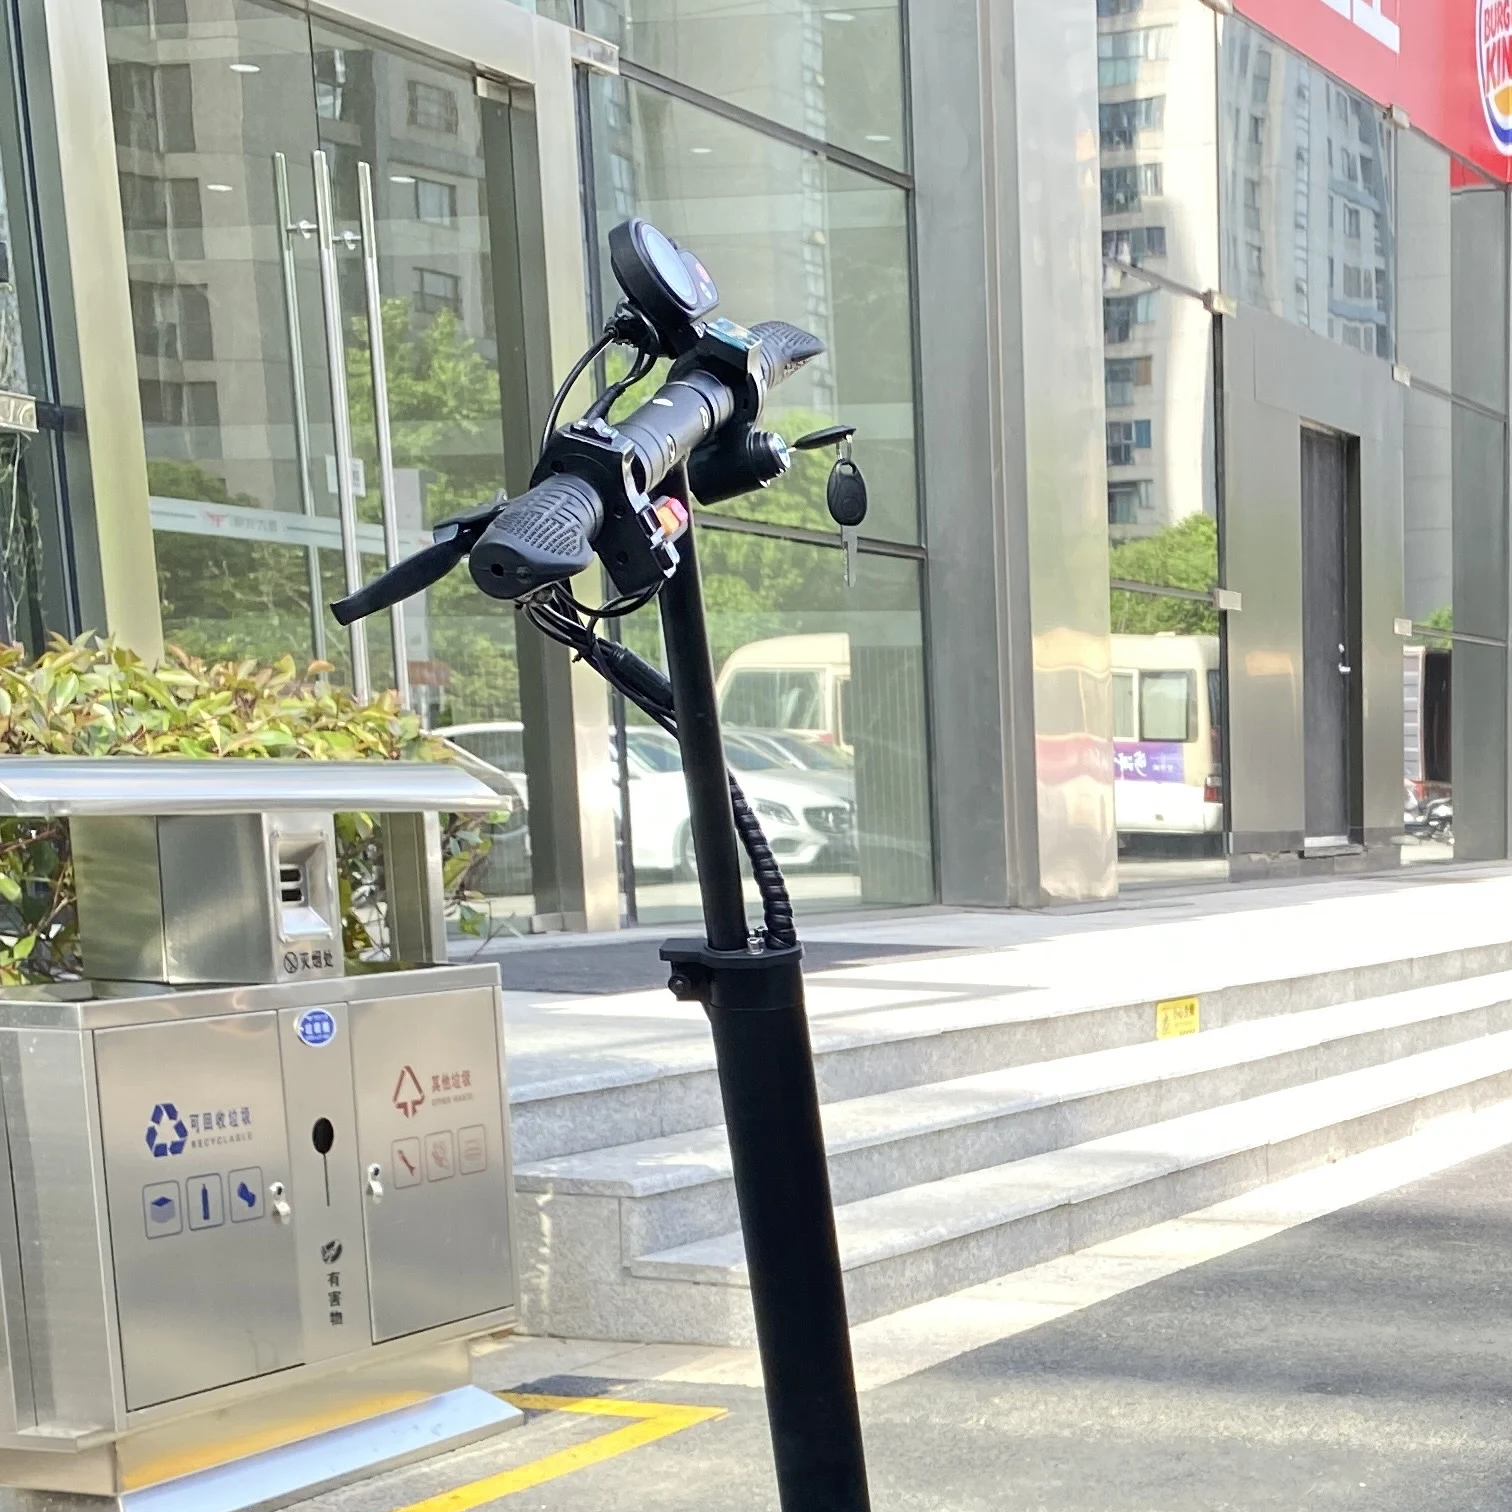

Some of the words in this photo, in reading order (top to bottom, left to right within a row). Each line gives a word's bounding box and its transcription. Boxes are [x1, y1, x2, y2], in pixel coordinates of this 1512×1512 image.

[300, 948, 334, 969] 灭烟处
[189, 1106, 251, 1133] 可回收垃圾
[191, 1131, 253, 1148] RECYCLABLE
[327, 1271, 343, 1325] 有害物
